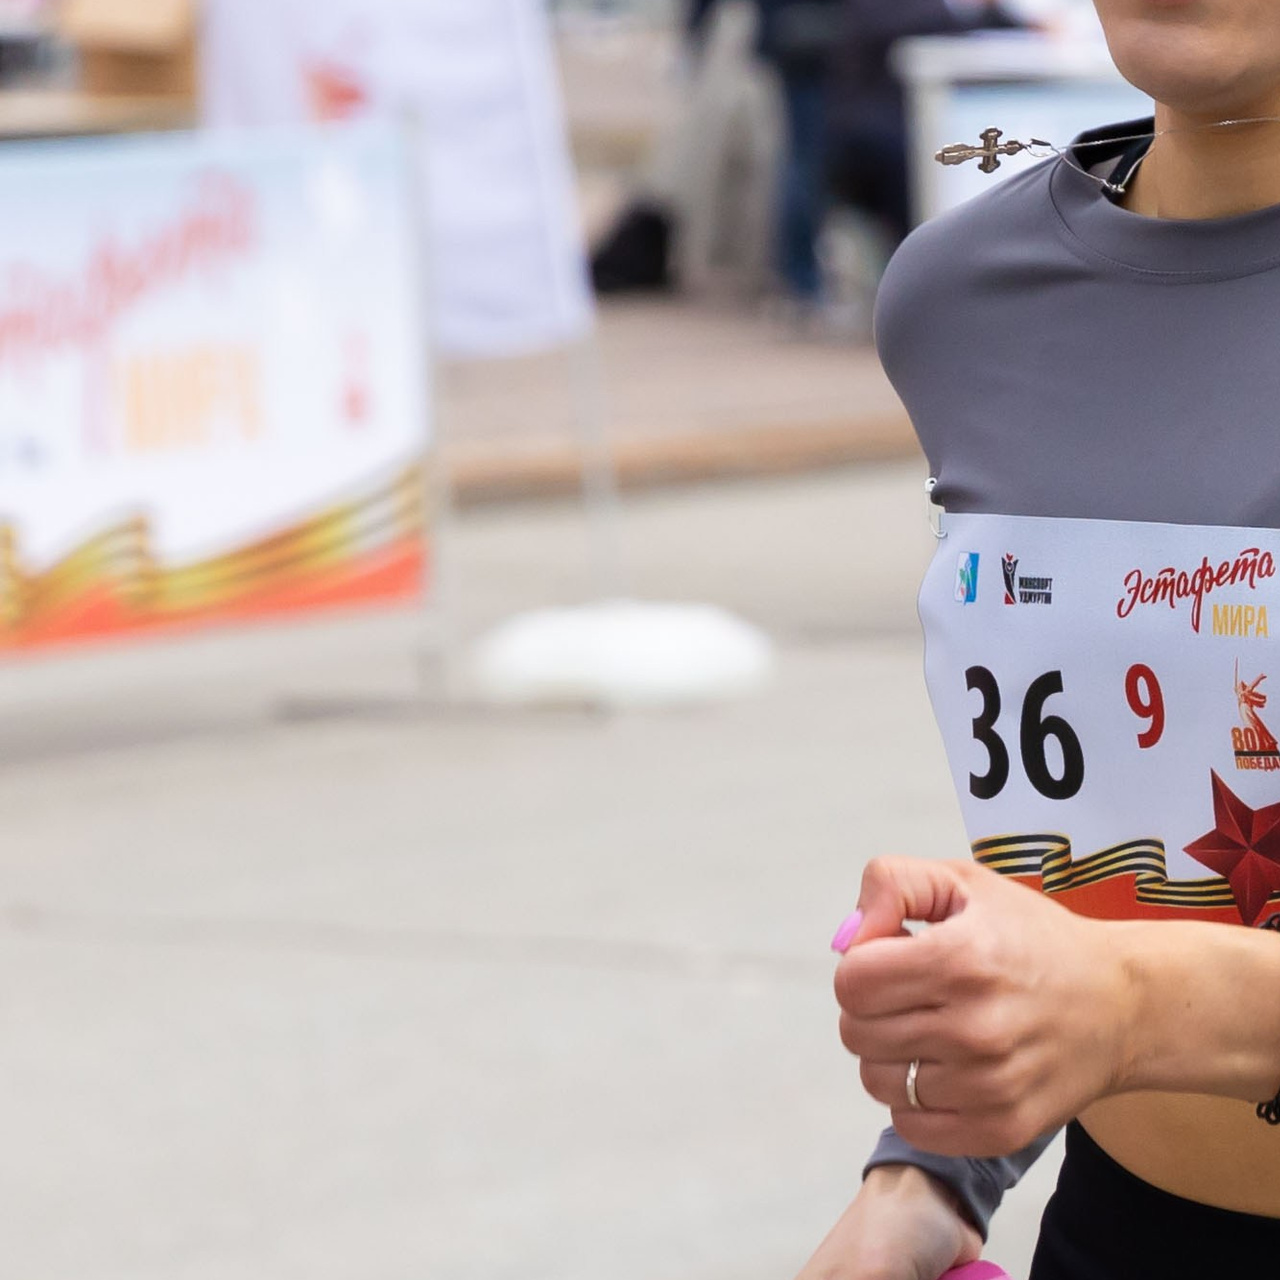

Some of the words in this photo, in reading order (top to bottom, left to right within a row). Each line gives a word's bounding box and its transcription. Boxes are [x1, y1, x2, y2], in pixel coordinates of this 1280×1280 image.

[1117, 548, 1276, 634] Эстафета
[1212, 604, 1269, 638] МИРА
[965, 665, 1085, 800] 36
[1124, 663, 1165, 749] 9
